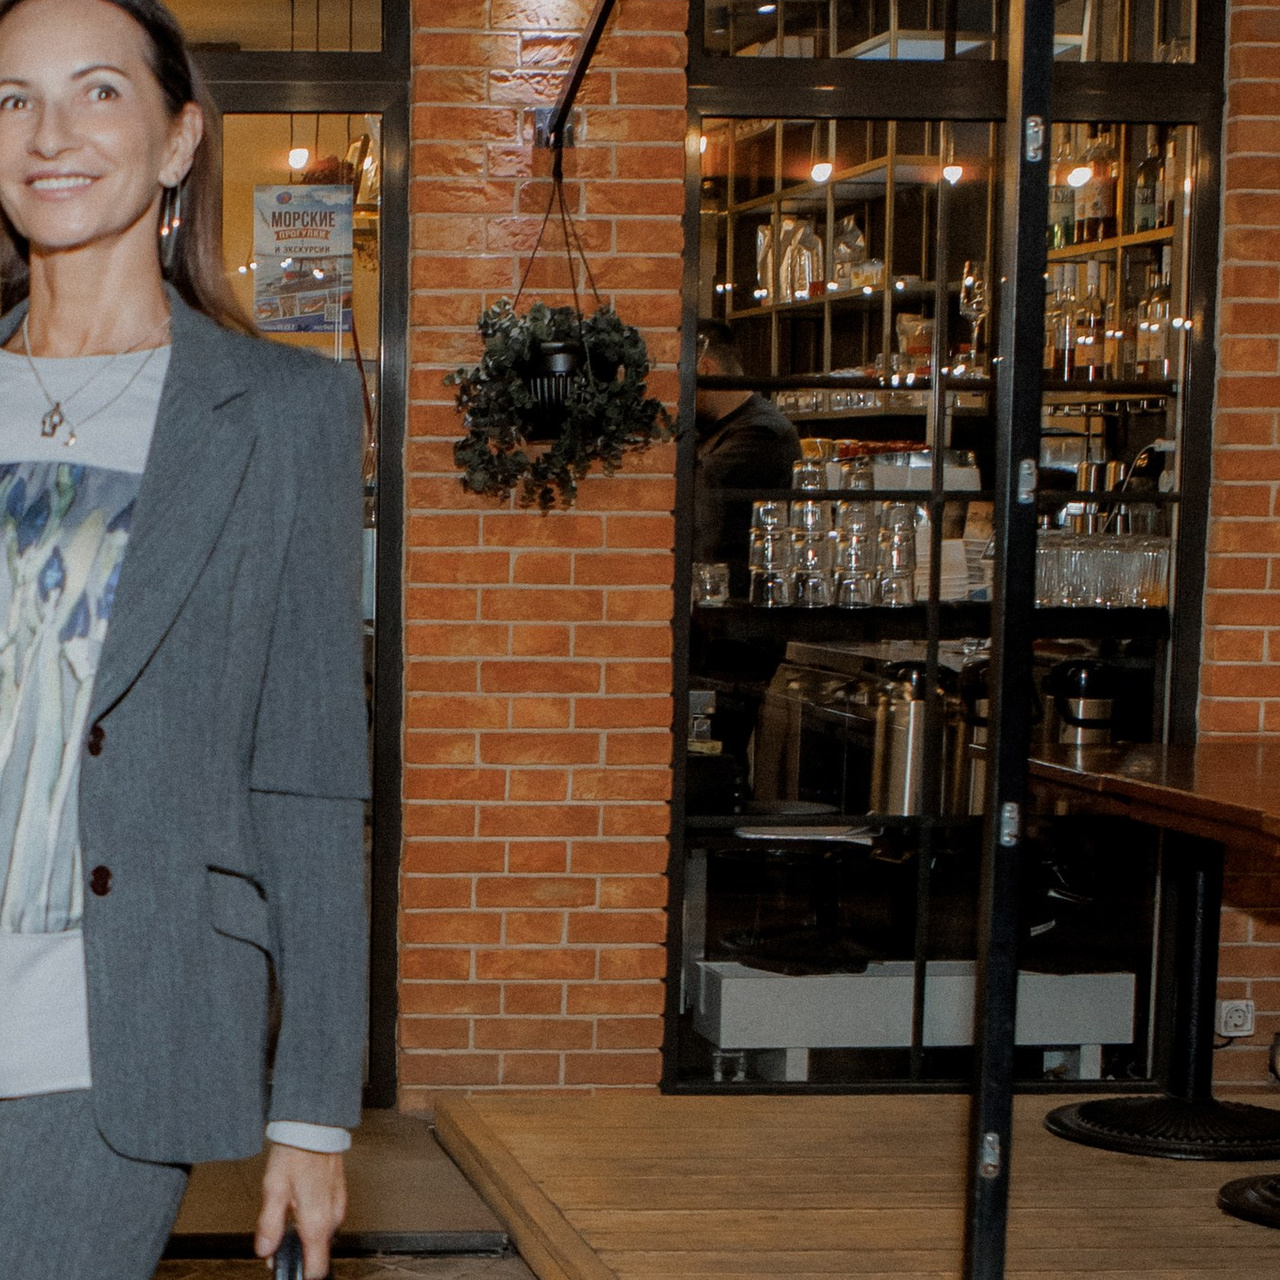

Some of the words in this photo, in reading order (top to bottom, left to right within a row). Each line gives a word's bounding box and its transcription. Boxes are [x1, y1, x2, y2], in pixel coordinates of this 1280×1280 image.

[271, 211, 336, 228] МОРСКИЕ
[279, 229, 326, 239] ПРОГУЛКИ
[283, 246, 330, 254] ЭКСКУРСИИ
